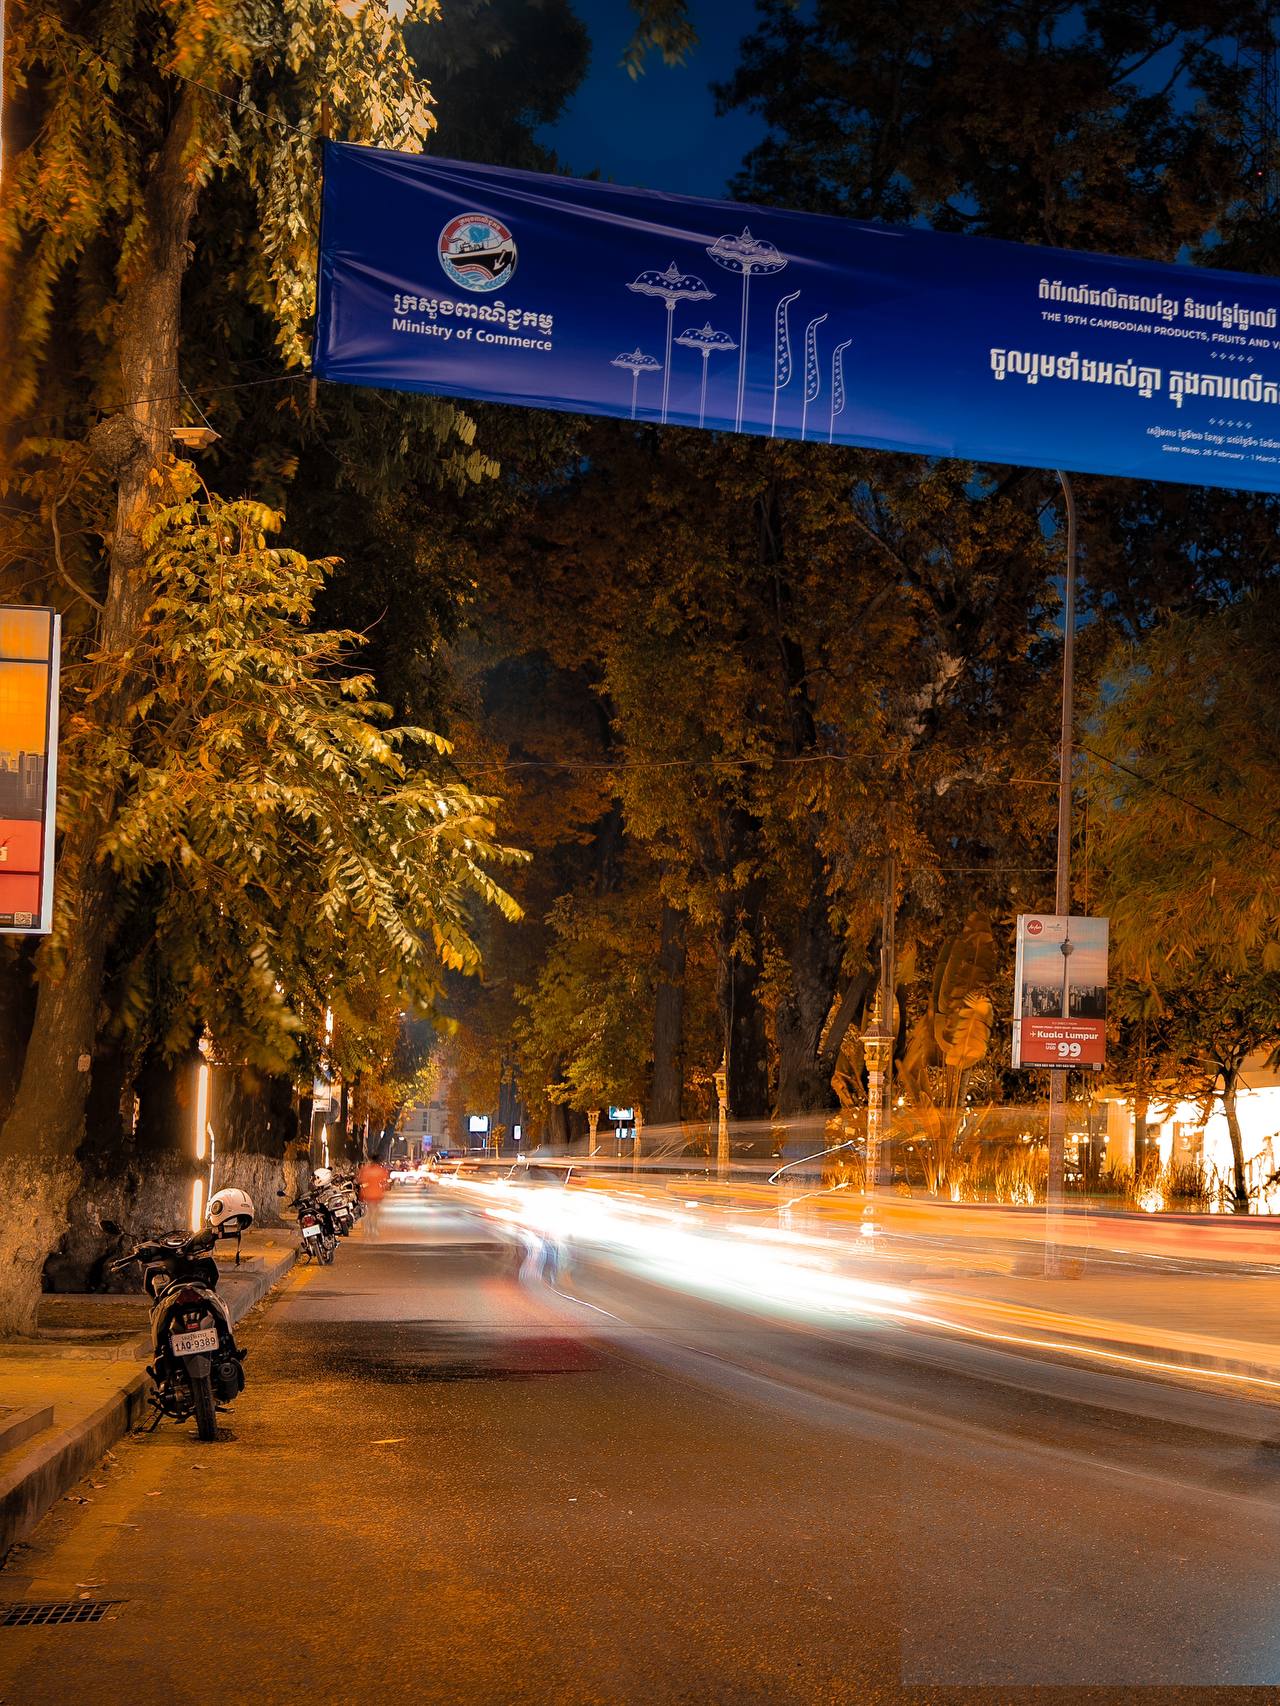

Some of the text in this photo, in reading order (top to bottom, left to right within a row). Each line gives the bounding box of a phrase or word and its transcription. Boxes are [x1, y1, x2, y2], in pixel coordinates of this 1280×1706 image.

[393, 293, 554, 335] ក្រសួងពាណិជ្ជកម្ម
[392, 317, 553, 351] Ministry of Commerce
[1041, 311, 1062, 322] THE
[1063, 314, 1088, 326] 19TH
[1089, 317, 1152, 334] CAMBODIAN
[1153, 326, 1210, 342] PRODUCTS,
[1211, 333, 1247, 346] FRUITS
[1248, 337, 1271, 348] AND
[1162, 444, 1180, 452] Siem
[1213, 449, 1244, 460] February
[1255, 454, 1277, 463] March
[1037, 1030, 1099, 1041] Kuala Lumpur
[1057, 1042, 1082, 1058] 99
